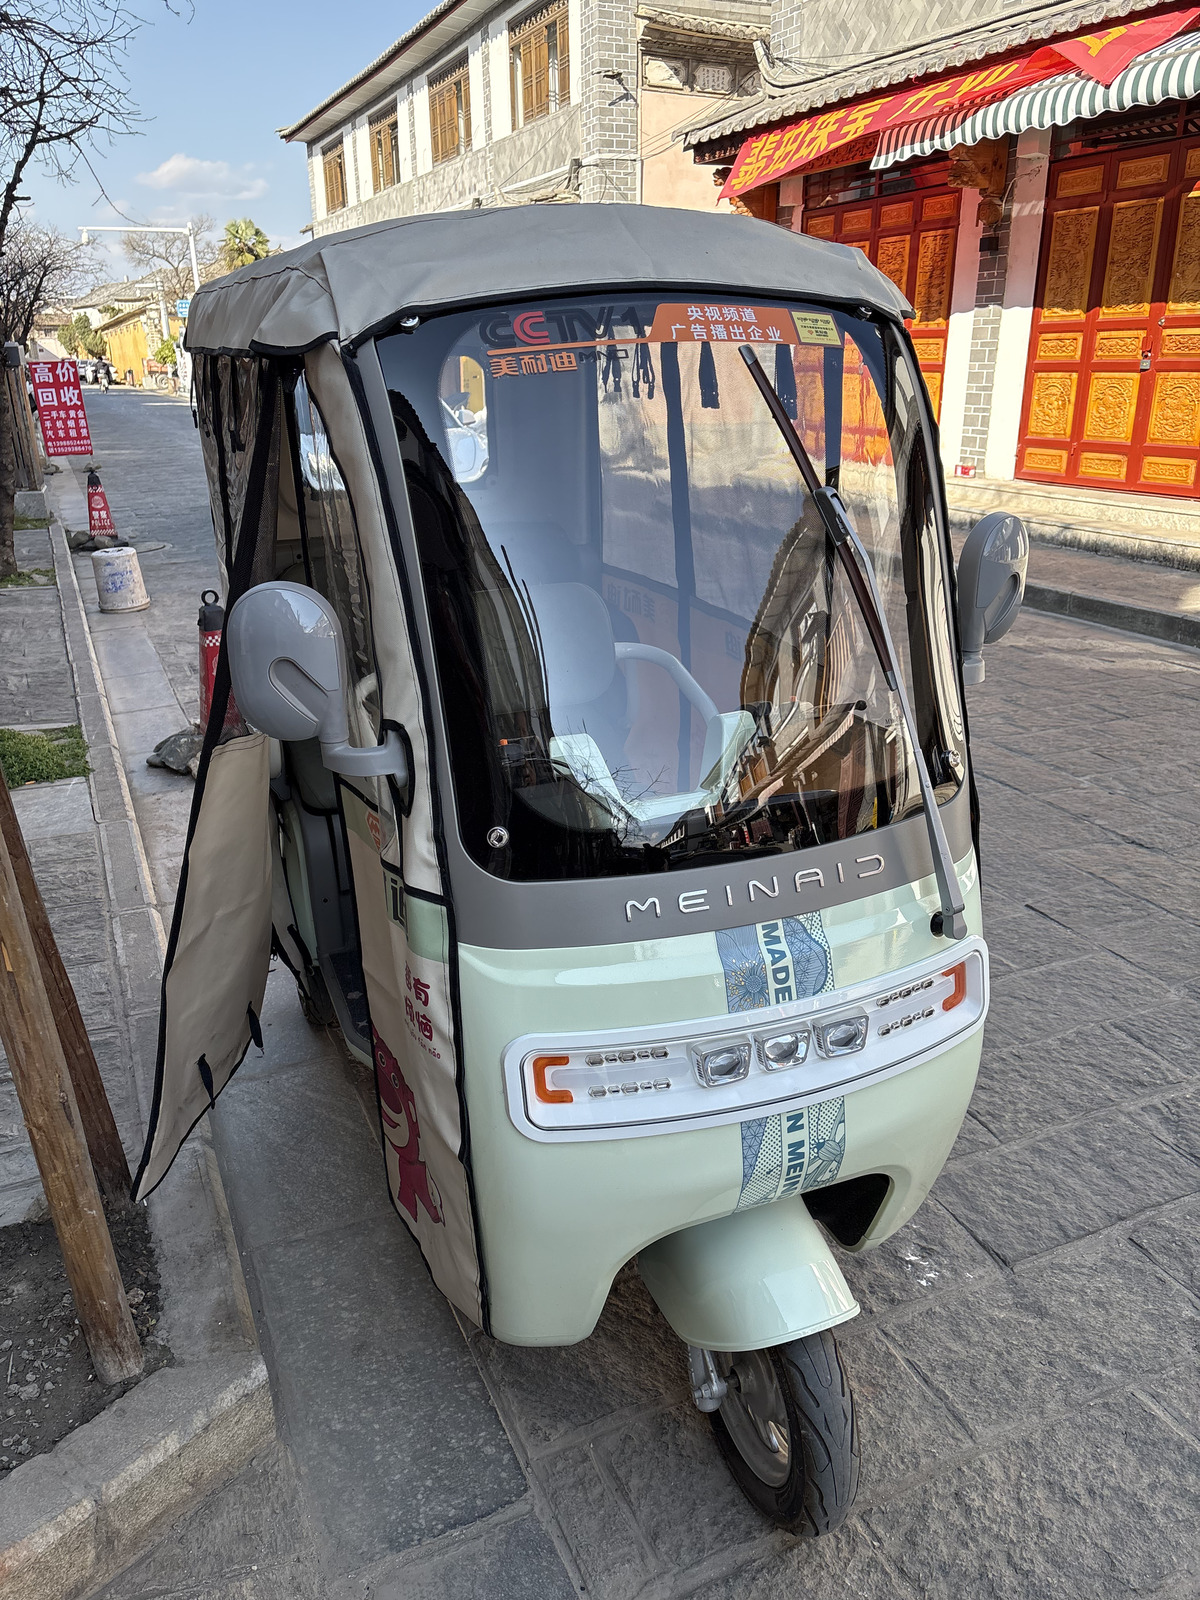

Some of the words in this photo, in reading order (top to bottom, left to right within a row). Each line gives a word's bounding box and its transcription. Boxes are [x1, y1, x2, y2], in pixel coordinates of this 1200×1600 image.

[687, 305, 757, 322] 央视频道
[671, 323, 783, 341] 广告播出企业
[32, 362, 75, 383] 高价
[489, 352, 578, 378] 美耐迪
[37, 386, 81, 407] 回收
[625, 853, 886, 923] MEINAID
[761, 921, 794, 1005] MADE
